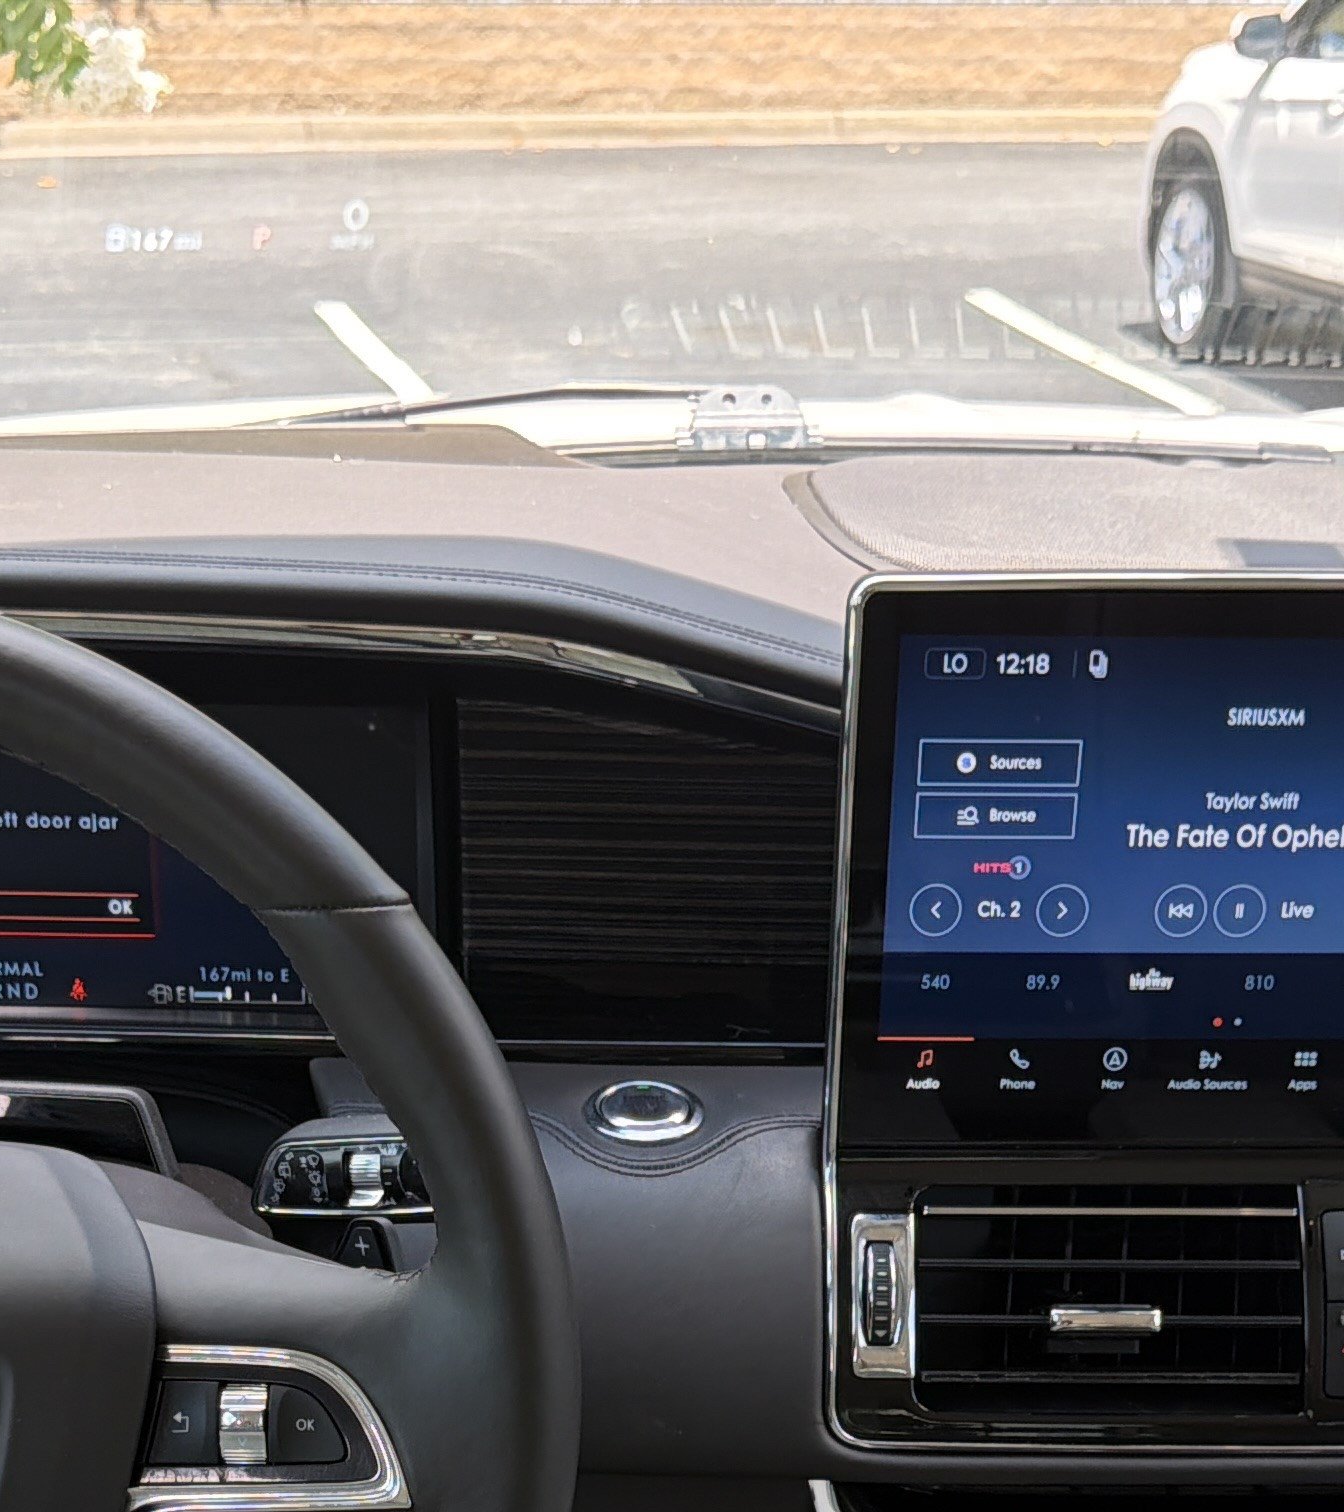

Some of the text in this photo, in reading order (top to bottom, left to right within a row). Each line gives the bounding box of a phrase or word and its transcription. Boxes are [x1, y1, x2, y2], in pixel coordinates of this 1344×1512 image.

[943, 654, 1050, 675] LO 12:18
[1227, 708, 1306, 727] SIRIUSXM
[990, 755, 1042, 770] Sources
[1206, 792, 1300, 813] Taylor Swift
[25, 811, 71, 830] door
[79, 813, 119, 833] ajar
[989, 807, 1037, 823] Browse
[1127, 824, 1170, 849] The
[1176, 824, 1230, 849] Fate
[1236, 824, 1267, 849] Of
[108, 900, 133, 915] OK
[977, 900, 1022, 918] Ch. 2
[1281, 902, 1314, 919] Live
[258, 968, 274, 983] to
[281, 968, 290, 983] E
[920, 973, 951, 991] 540
[1026, 973, 1061, 991] 89.9
[1244, 973, 1275, 991] 810
[176, 985, 187, 1004] E
[906, 1078, 941, 1091] Audio
[999, 1078, 1036, 1091] Phone
[1101, 1078, 1124, 1091] Nav
[1167, 1078, 1249, 1091] Audio Sources
[1287, 1078, 1318, 1094] Apps
[296, 1418, 315, 1431] OK
